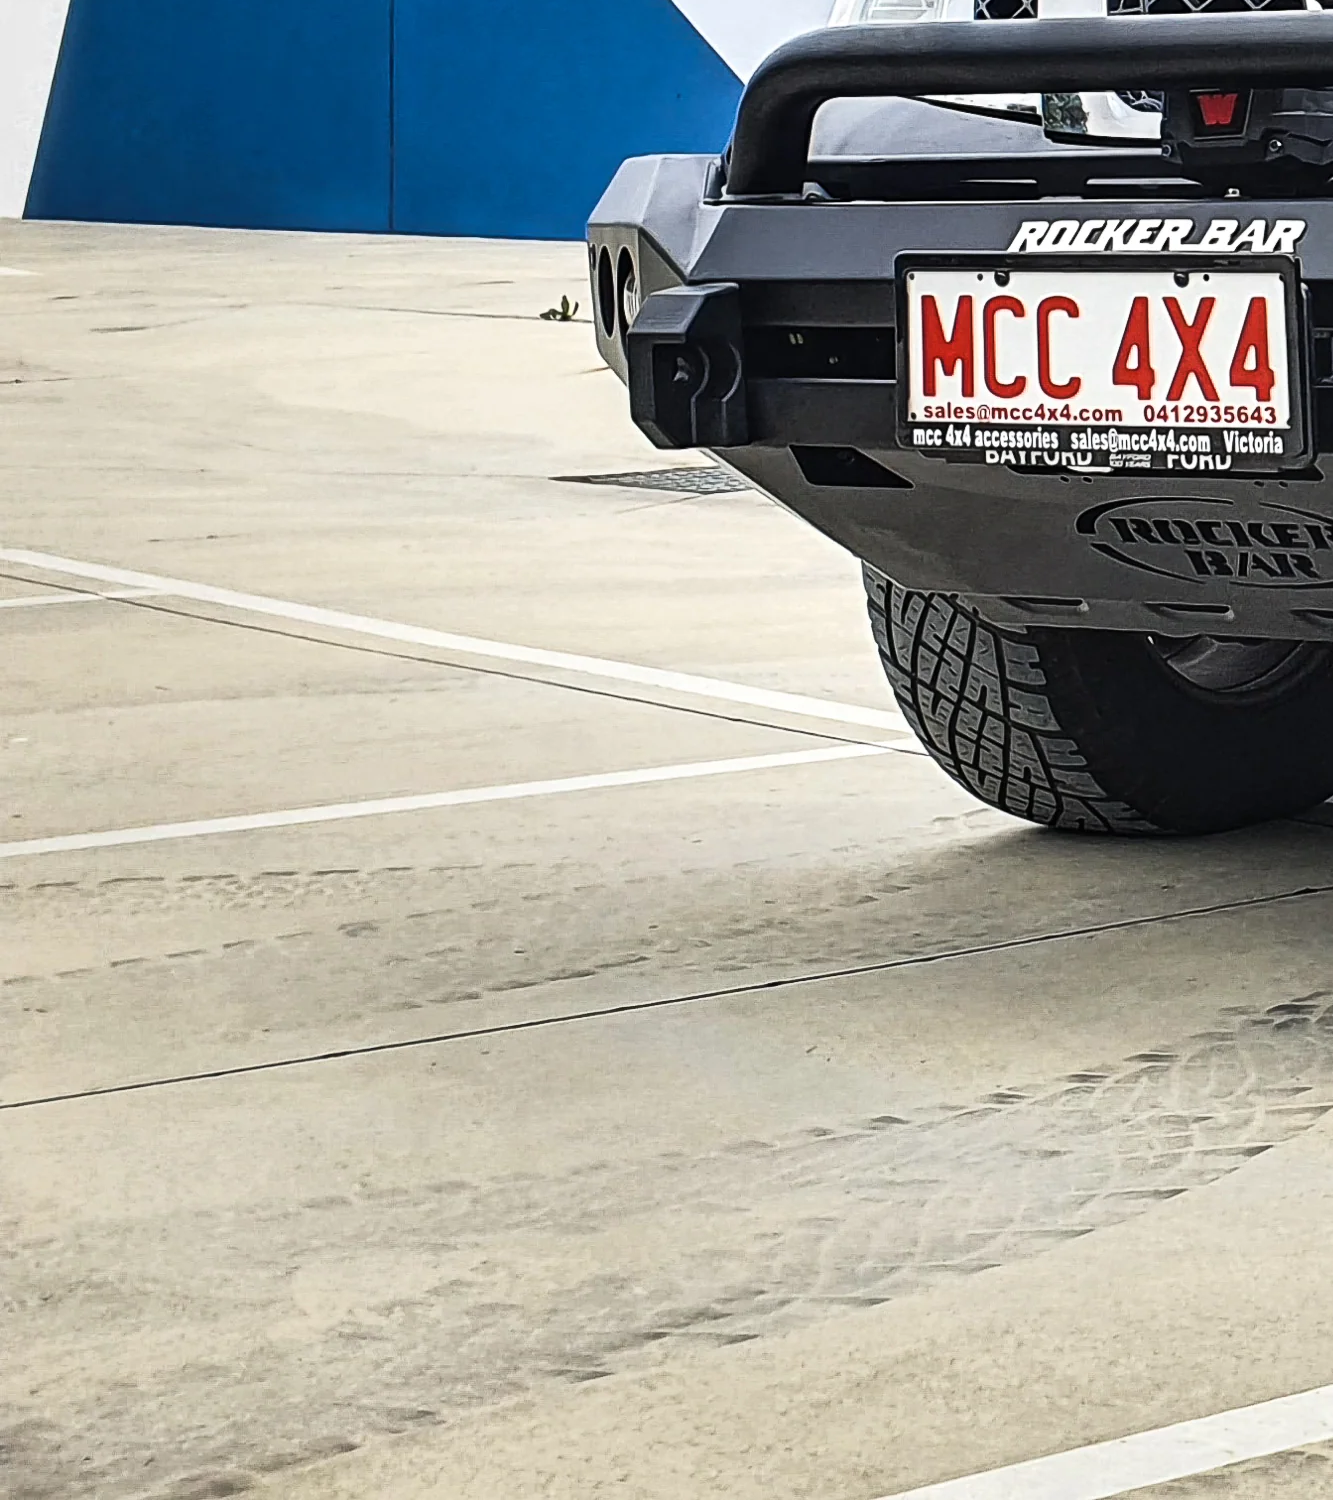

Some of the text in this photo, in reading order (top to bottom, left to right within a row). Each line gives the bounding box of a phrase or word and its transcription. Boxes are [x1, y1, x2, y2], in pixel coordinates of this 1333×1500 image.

[1007, 219, 1305, 252] ROCKER BAR
[921, 295, 1275, 402] MCC 4X4
[923, 401, 1277, 424] sales@mcc4x4.com 0412935643
[913, 423, 1284, 454] mcc 4x4 accessories sales@mcc4x4.com Victoria
[1184, 549, 1321, 579] BAR
